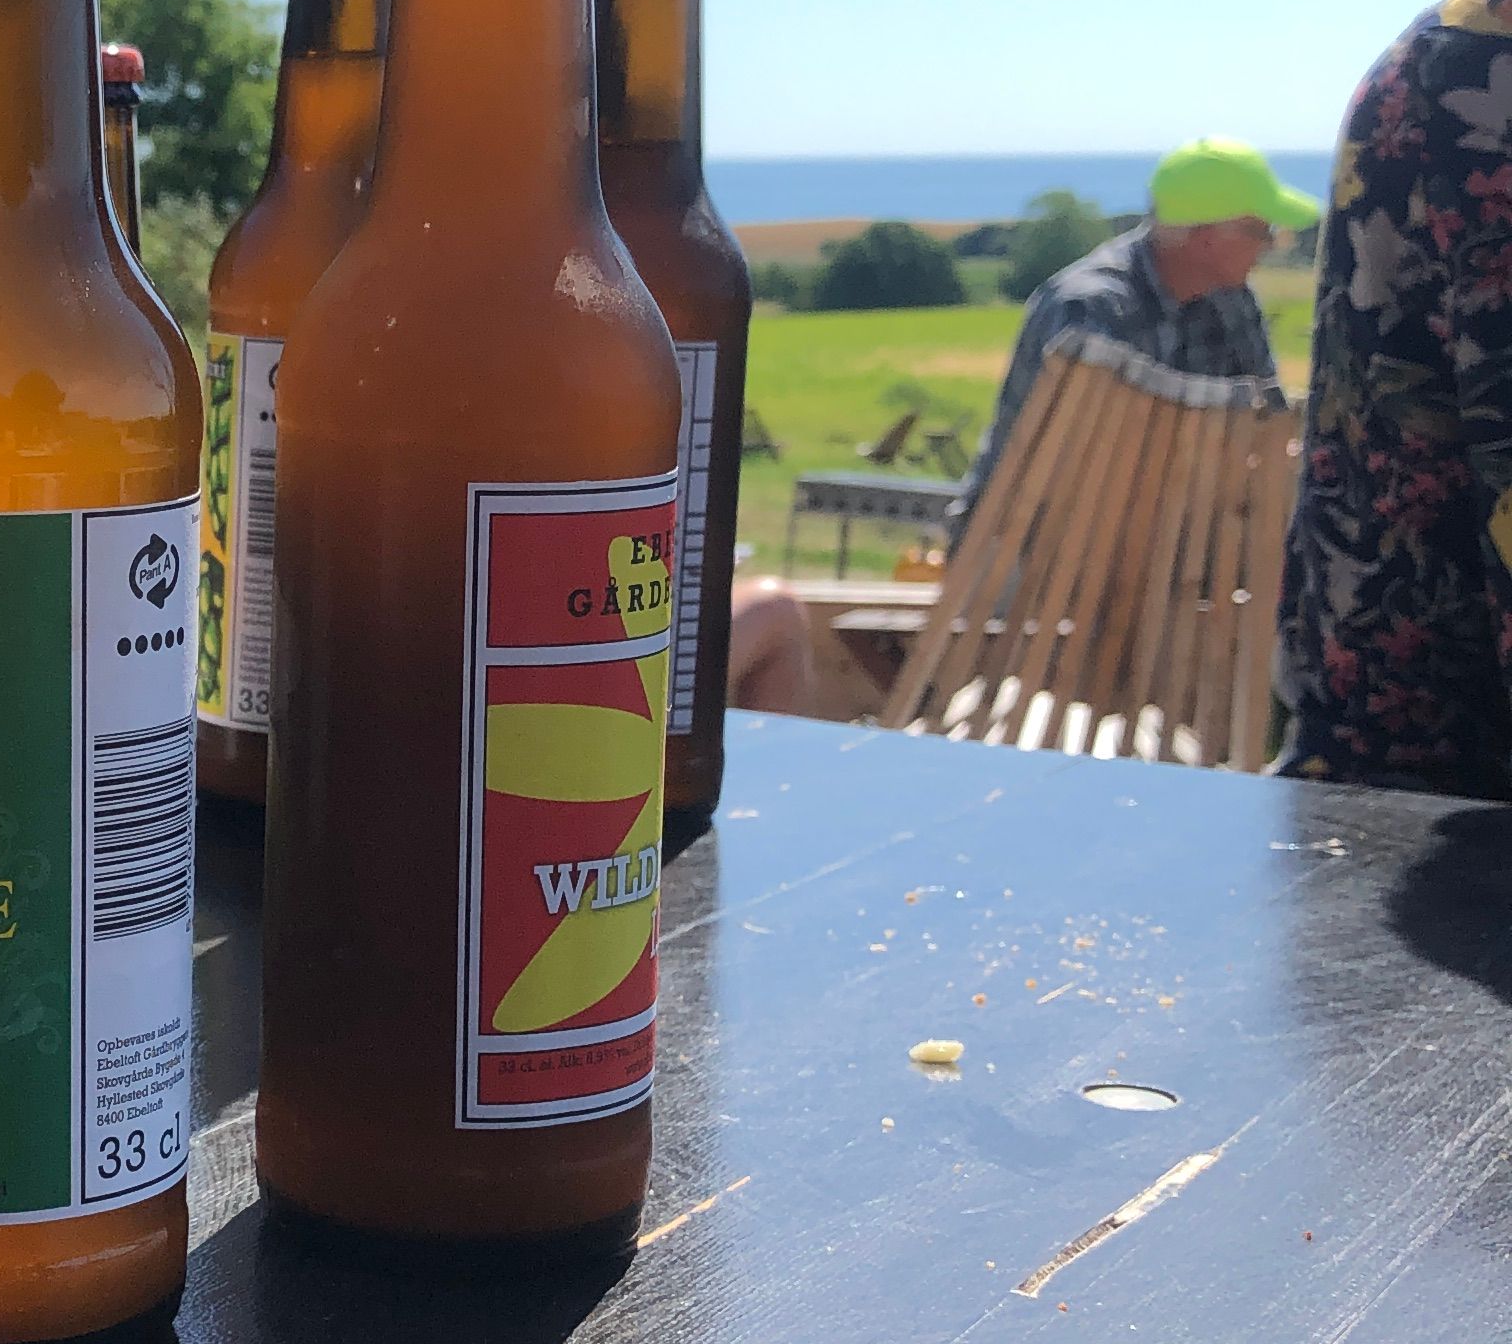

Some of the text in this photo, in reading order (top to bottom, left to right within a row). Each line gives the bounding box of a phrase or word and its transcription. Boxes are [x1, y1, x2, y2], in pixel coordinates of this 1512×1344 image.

[631, 529, 671, 565] EB
[139, 554, 171, 584] Pant A
[238, 688, 269, 716] 33
[533, 840, 662, 915] WILD
[97, 1016, 181, 1055] Opbevares iskoldt
[96, 1050, 141, 1072] Ebeltoft
[96, 1066, 154, 1090] Skovgårde
[96, 1084, 149, 1111] Hyllested
[96, 1097, 164, 1127] 8400 Ebeltoft
[98, 1110, 181, 1180] 33 cl
